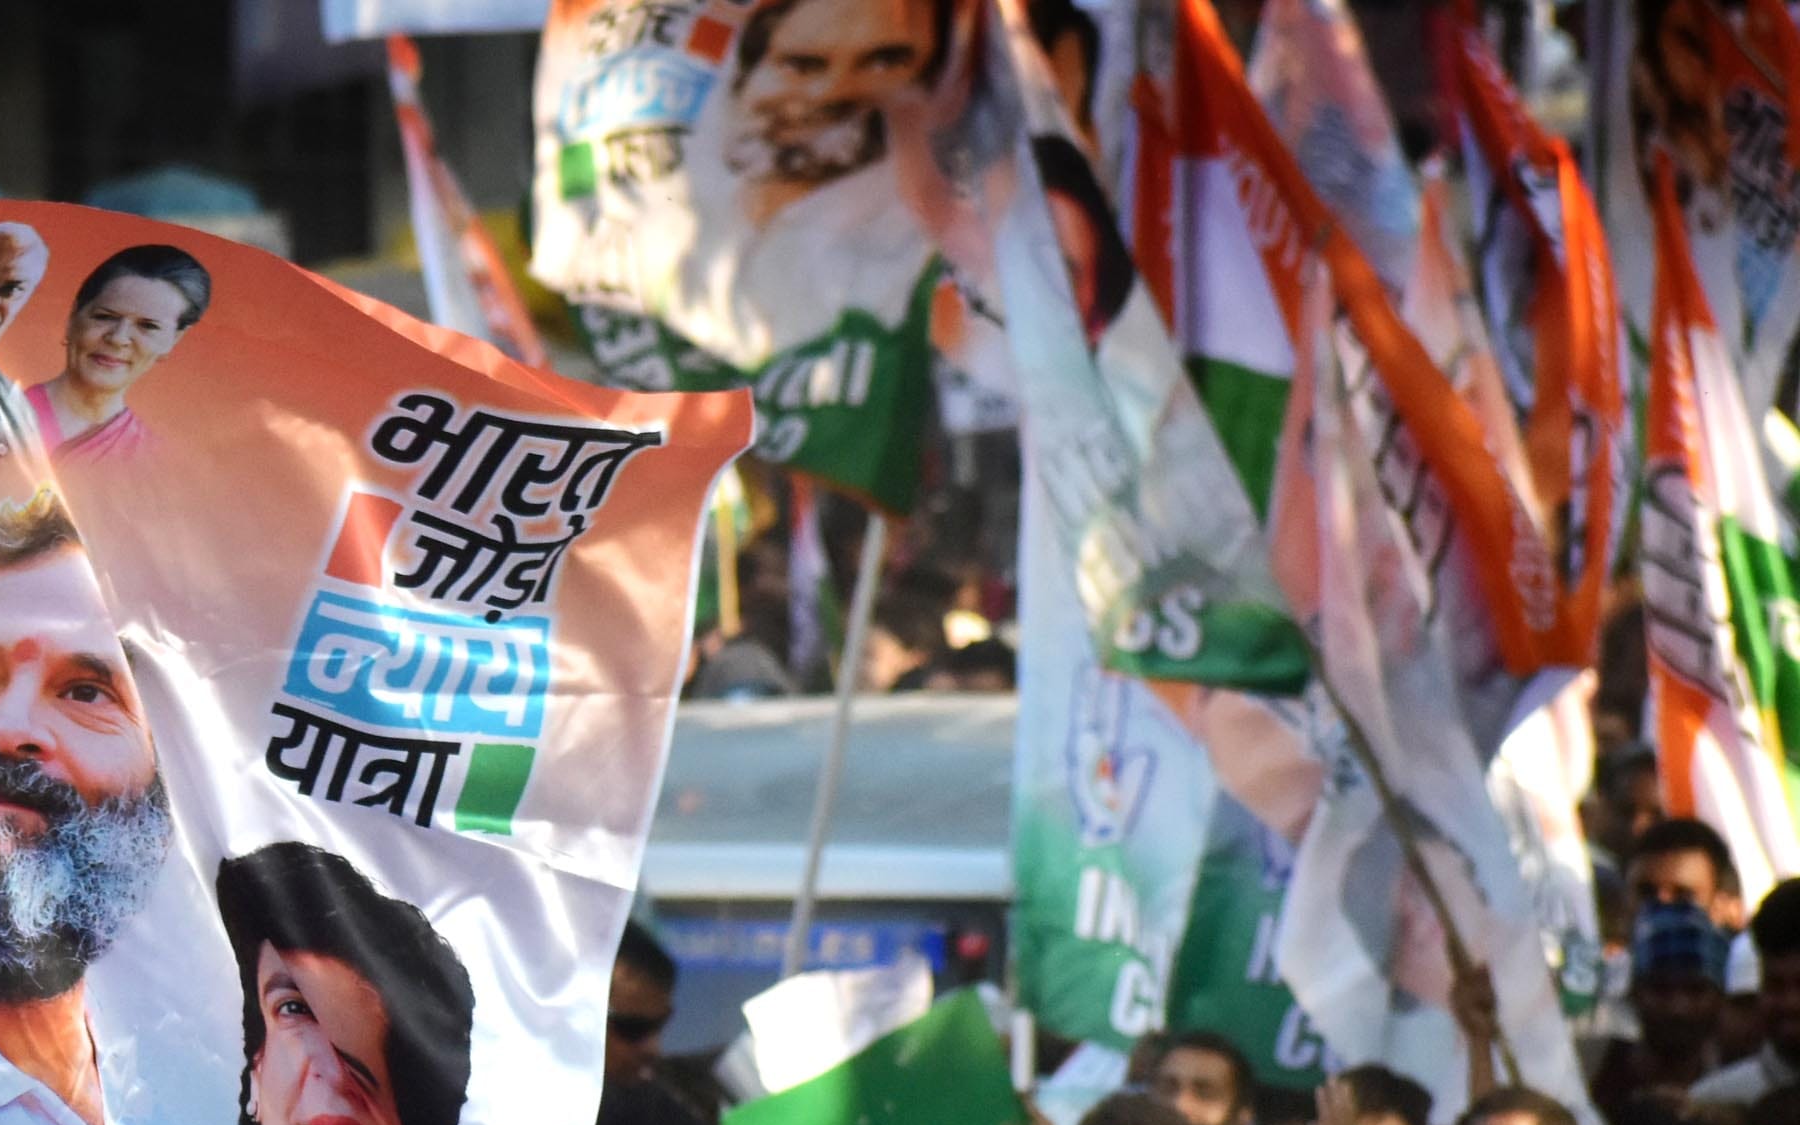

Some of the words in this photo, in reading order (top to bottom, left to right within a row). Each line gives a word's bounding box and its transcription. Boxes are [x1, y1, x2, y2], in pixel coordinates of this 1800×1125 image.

[370, 393, 663, 517] भारत
[304, 600, 544, 730] न्याय
[264, 702, 462, 829] यात्रा
